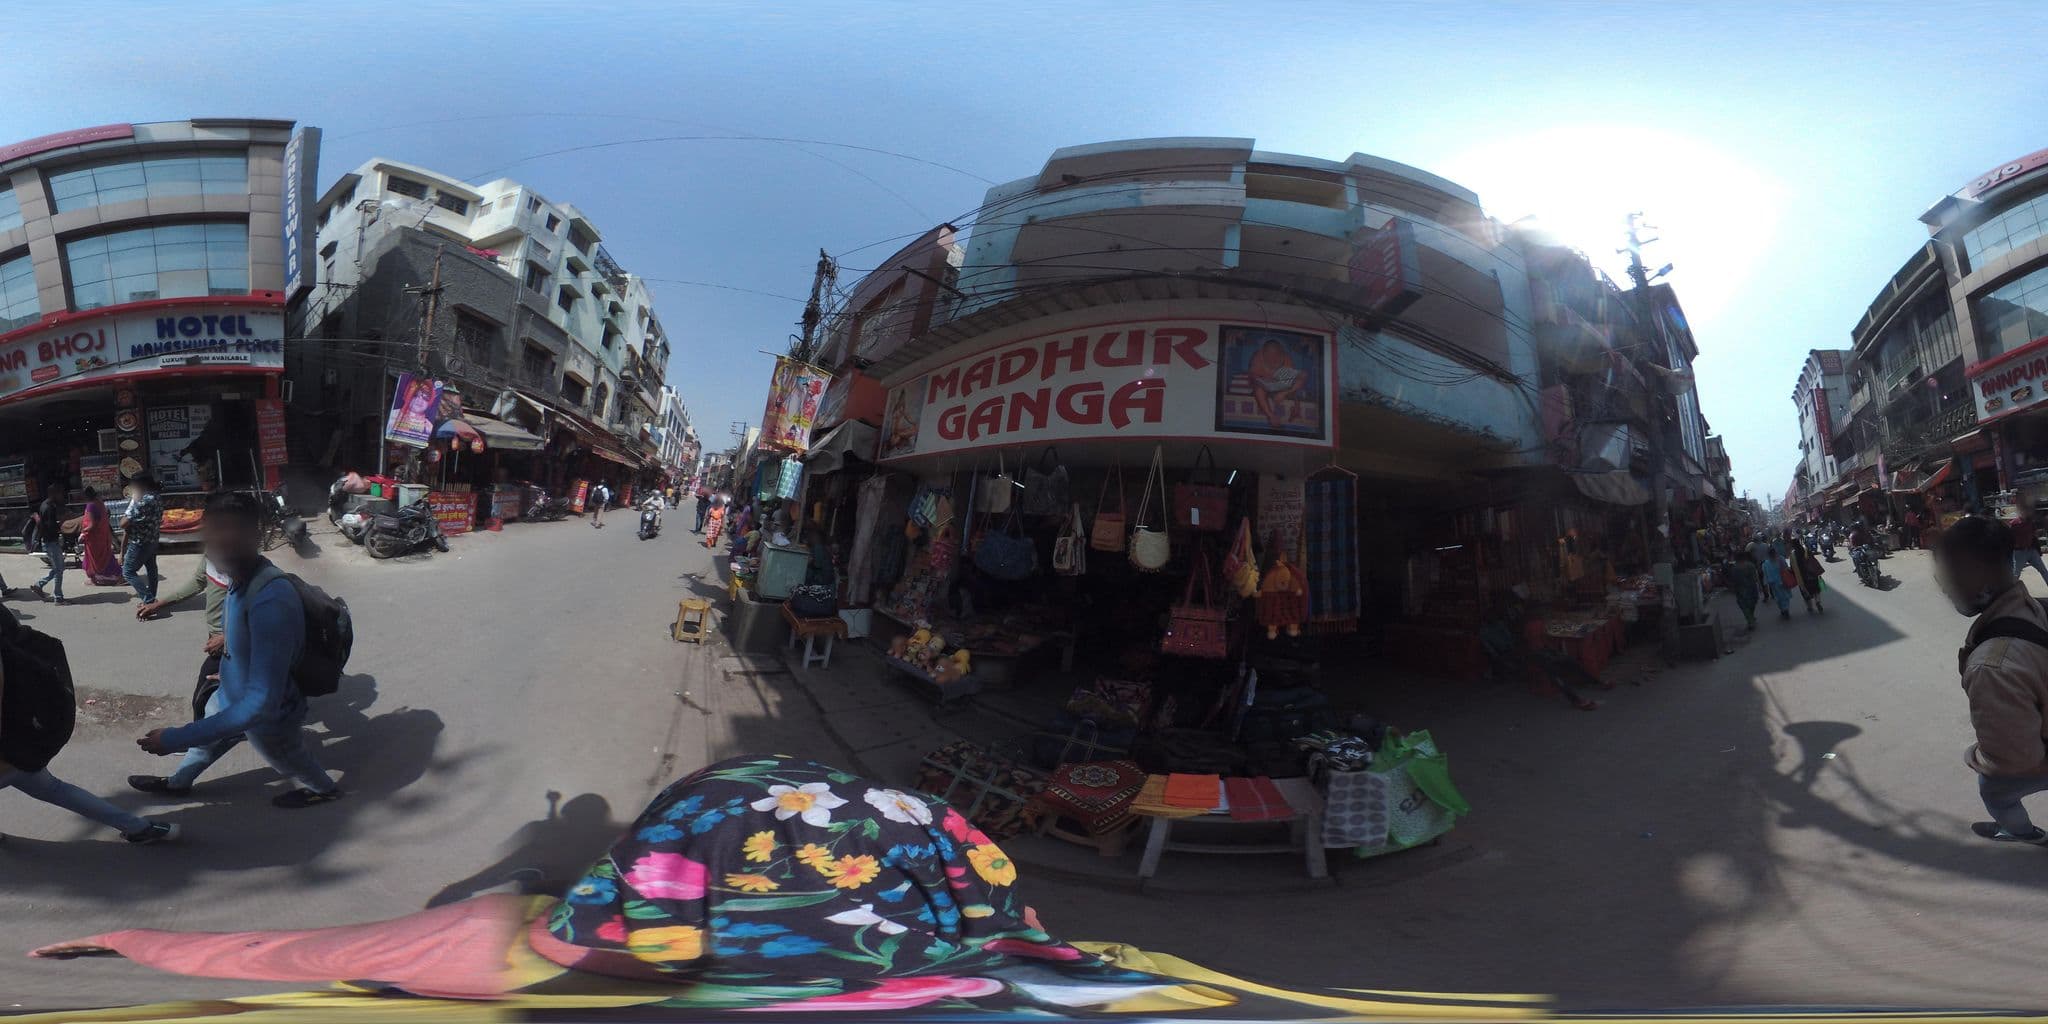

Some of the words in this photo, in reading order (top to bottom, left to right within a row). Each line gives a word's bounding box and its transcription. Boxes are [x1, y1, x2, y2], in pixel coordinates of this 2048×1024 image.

[1976, 163, 2022, 188] OYO
[156, 315, 253, 340] HOTEL
[38, 328, 105, 362] BHOJ
[927, 328, 1211, 405] MADHUR
[150, 409, 187, 421] HOTEL
[937, 378, 1166, 442] GANGA
